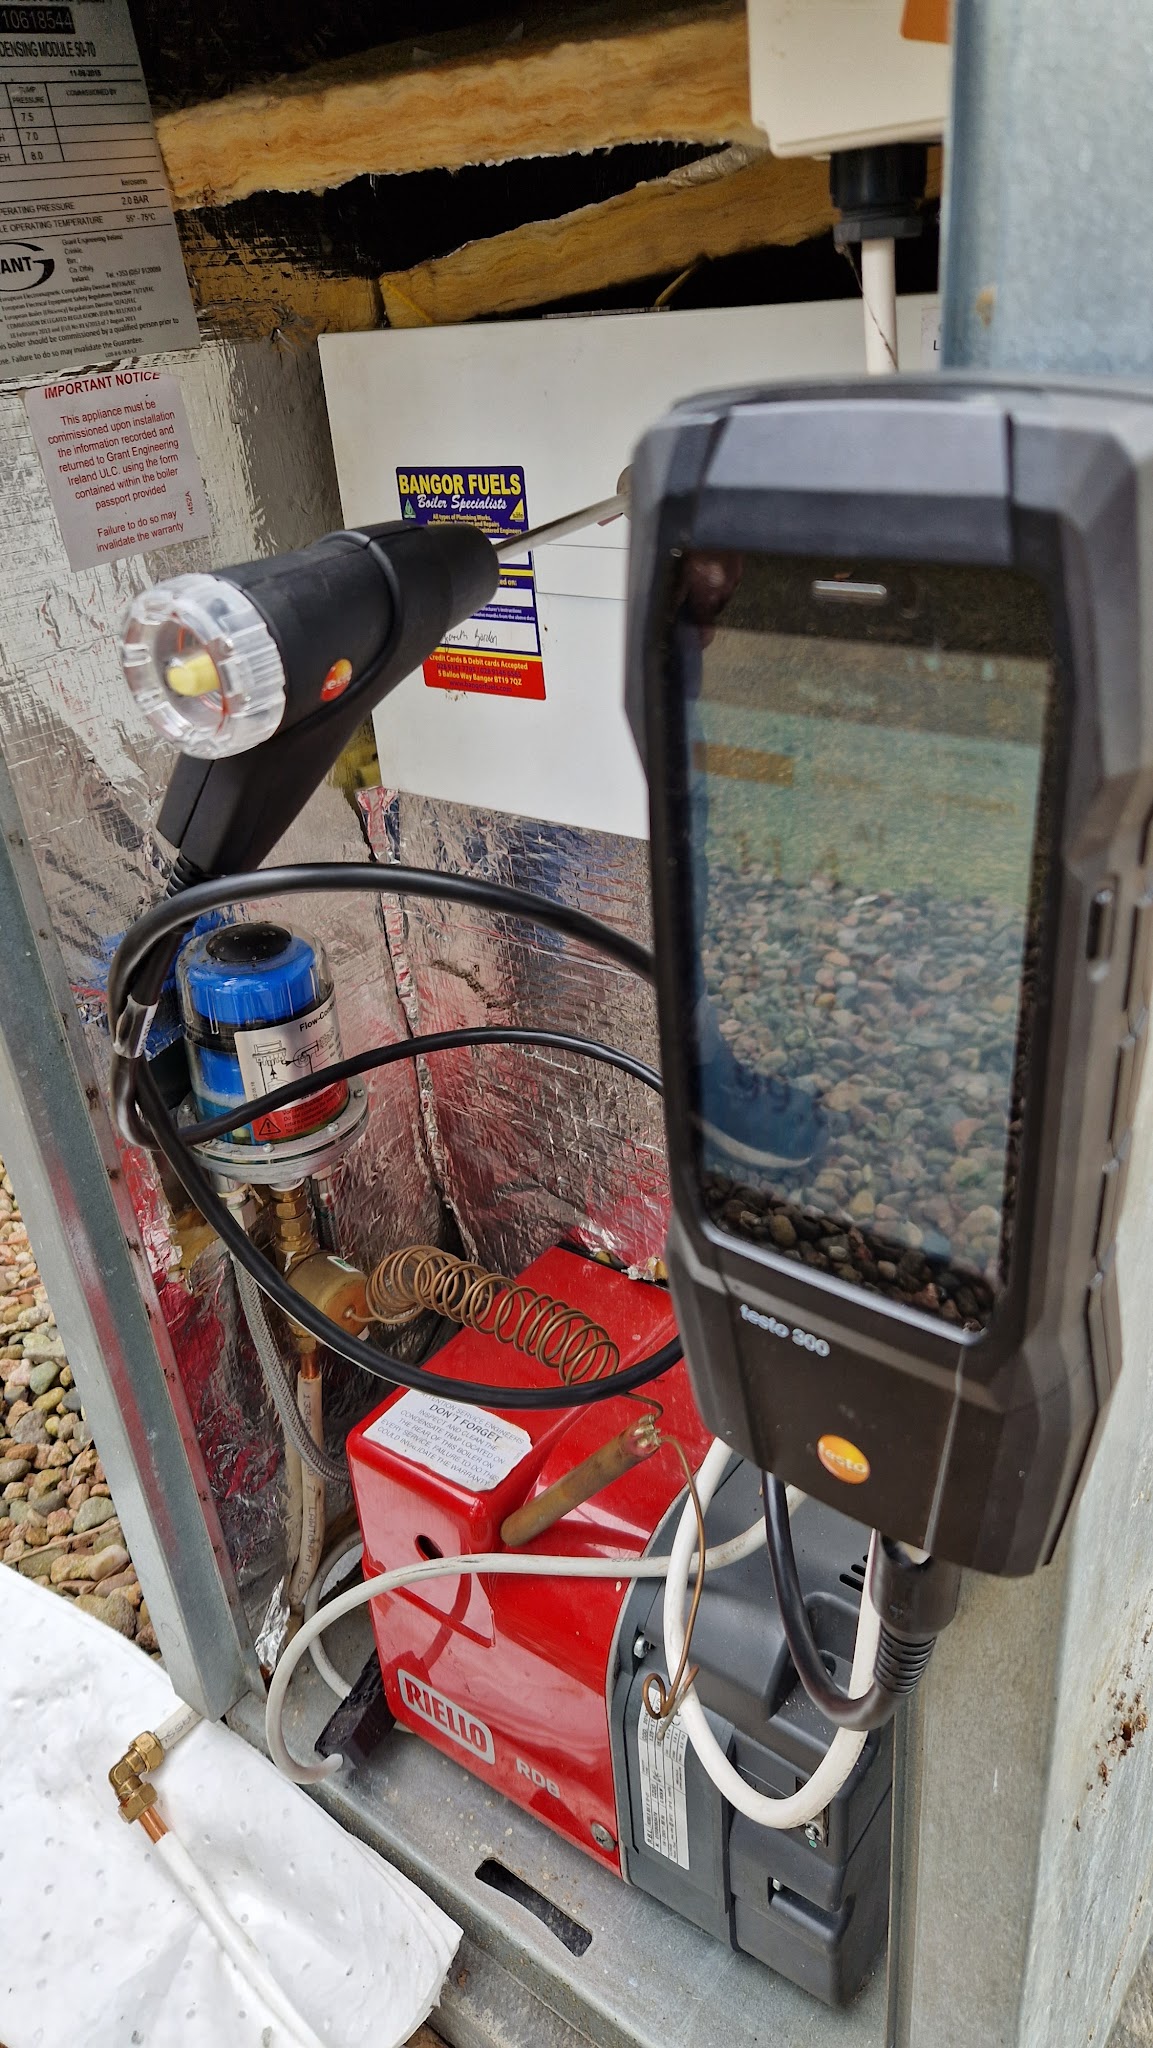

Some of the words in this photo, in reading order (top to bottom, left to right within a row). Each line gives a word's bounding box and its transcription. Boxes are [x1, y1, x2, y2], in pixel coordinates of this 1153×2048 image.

[38, 41, 74, 58] MODULE
[36, 202, 75, 213] PRESSURE
[133, 195, 150, 204] BAR
[10, 221, 52, 232] OPERATING
[54, 216, 104, 228] TEMPERATURE
[7, 340, 26, 350] boiler
[28, 336, 48, 346] should
[58, 328, 100, 342] commissioned
[101, 328, 109, 336] by
[114, 322, 138, 334] qualified
[140, 321, 158, 330] person
[159, 318, 172, 328] prior
[12, 354, 33, 364] Failure
[34, 352, 42, 360] to
[42, 350, 50, 359] do
[60, 348, 73, 356] may
[74, 342, 102, 353] invalidate
[102, 340, 112, 348] the
[44, 375, 112, 400] IMPORTANT
[116, 371, 161, 386] NOTICE
[47, 425, 109, 445] commissioned
[110, 420, 132, 434] upon
[132, 410, 176, 427] installation
[60, 414, 80, 427] This
[82, 406, 123, 424] appliance
[124, 402, 145, 414] must
[145, 400, 157, 410] be
[57, 446, 72, 458] the
[73, 436, 120, 455] information
[121, 429, 158, 445] recorded
[158, 424, 175, 436] and
[59, 457, 95, 473] returned
[96, 456, 105, 466] to
[106, 449, 131, 464] Grant
[132, 438, 180, 457] Engineering
[67, 471, 98, 486] Ireland
[99, 465, 121, 479] ULC.
[122, 461, 145, 475] using
[145, 457, 159, 468] the
[159, 452, 179, 465] form
[74, 484, 116, 500] contained
[116, 476, 142, 490] within
[142, 472, 155, 483] the
[156, 467, 179, 480] boiler
[399, 474, 465, 495] BANGOR
[468, 474, 521, 495] FUELS
[95, 493, 131, 511] passport
[132, 484, 167, 501] provided
[417, 494, 447, 509] Boiler
[451, 494, 507, 512] Specialists
[96, 523, 126, 538] Failure
[127, 521, 136, 531] to
[137, 517, 148, 528] do
[149, 514, 160, 524] so
[160, 509, 178, 523] may
[96, 534, 136, 553] invalidate
[136, 532, 150, 543] the
[150, 521, 185, 539] warranty
[446, 655, 462, 663] Cards
[484, 659, 499, 667] cards
[501, 661, 528, 671] Accepted
[461, 672, 472, 681] Way
[473, 673, 493, 683] Bangor
[494, 675, 508, 684] BT19
[510, 678, 522, 686] 7QZ
[740, 1304, 790, 1338] testo
[399, 1409, 444, 1434] CONDENSATE
[443, 1431, 462, 1443] TRAP
[460, 1439, 493, 1458] LOCATED
[492, 1455, 505, 1464] ON
[417, 1409, 446, 1425] INSPECT
[445, 1423, 461, 1433] AND
[460, 1430, 484, 1444] CLEAN
[483, 1441, 498, 1451] THE
[428, 1404, 461, 1422] DON'T
[459, 1418, 502, 1442] FORGET
[455, 1408, 484, 1424] SERVICE
[484, 1422, 524, 1444] ENGINEERS
[376, 1426, 400, 1441] COULD
[399, 1437, 436, 1459] INVALIDATE
[436, 1456, 451, 1466] THE
[449, 1463, 490, 1486] WARRANTY
[380, 1418, 402, 1432] EVERY
[432, 1444, 461, 1462] FAILURE
[460, 1459, 471, 1467] TO
[470, 1464, 483, 1473] DO
[482, 1470, 499, 1481] THIS
[397, 1418, 412, 1427] THE
[411, 1424, 431, 1437] REAR
[429, 1434, 441, 1442] OF
[440, 1439, 457, 1450] THIS
[456, 1447, 482, 1463] BOILER
[481, 1460, 494, 1469] ON
[404, 1677, 488, 1754] RIELLO
[515, 1758, 561, 1799] RDB
